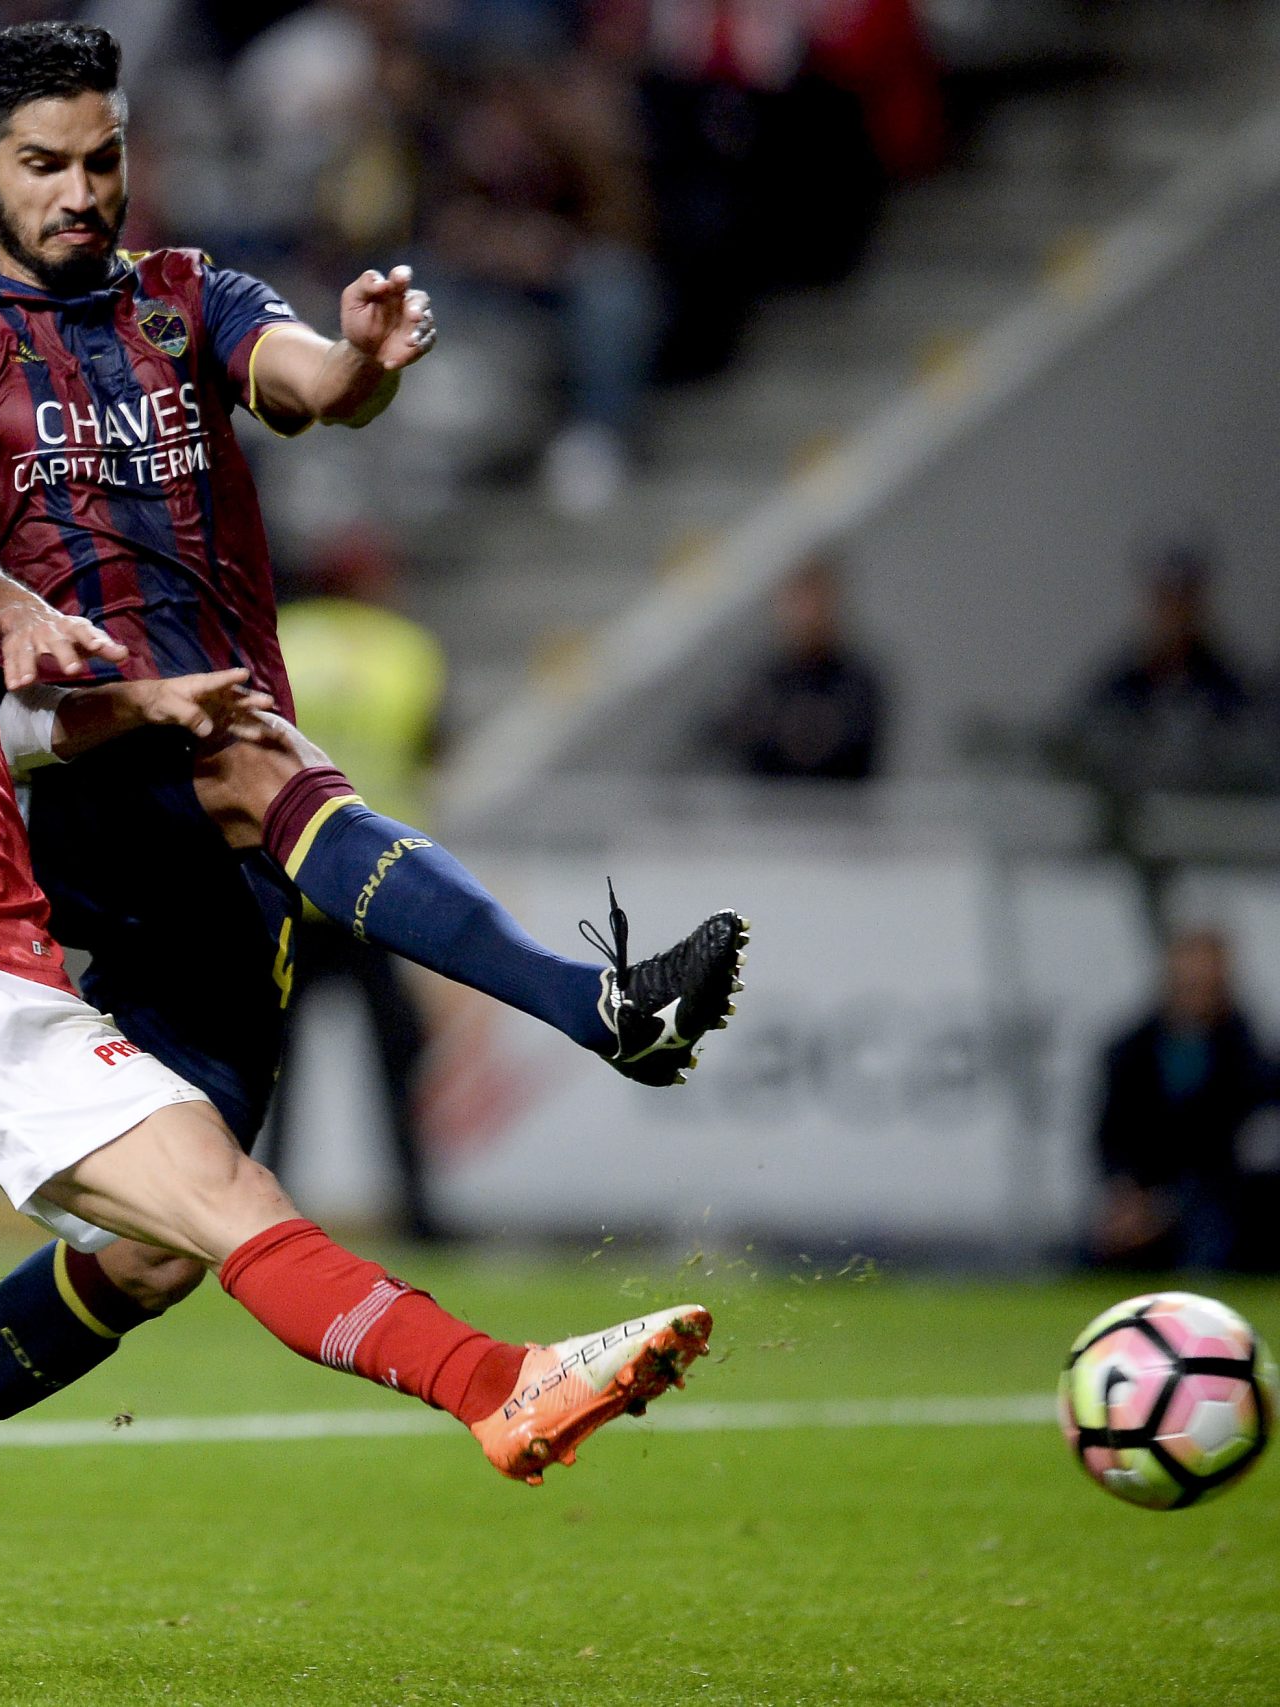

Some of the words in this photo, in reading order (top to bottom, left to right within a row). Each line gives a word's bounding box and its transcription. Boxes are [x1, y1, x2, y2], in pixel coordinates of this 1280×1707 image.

[36, 383, 202, 446] CHAVES
[14, 455, 127, 492] CAPITAL
[129, 441, 212, 486] TERM
